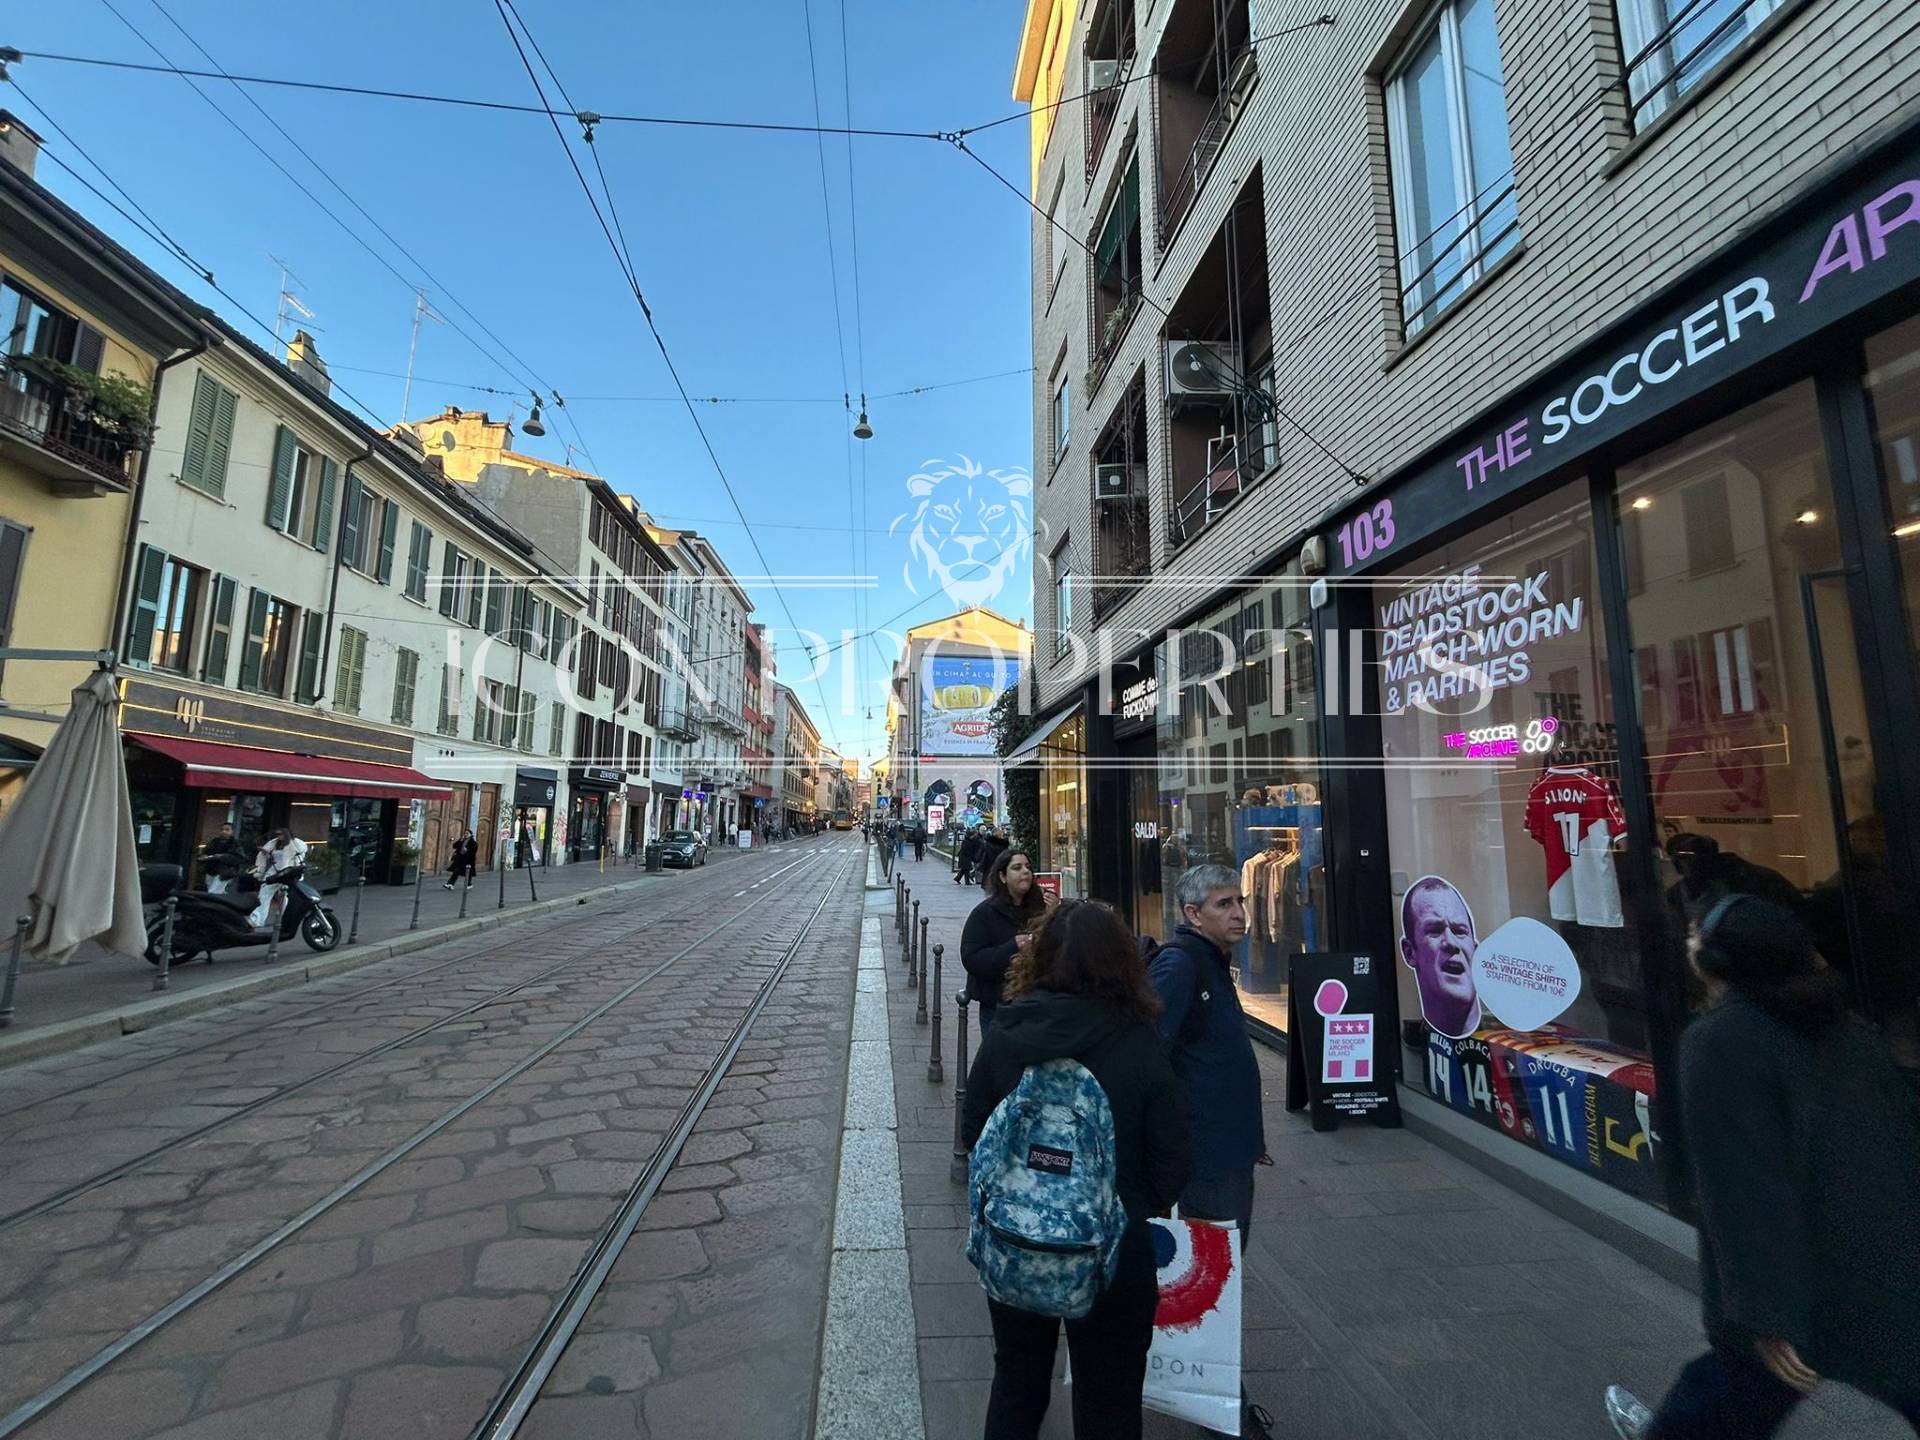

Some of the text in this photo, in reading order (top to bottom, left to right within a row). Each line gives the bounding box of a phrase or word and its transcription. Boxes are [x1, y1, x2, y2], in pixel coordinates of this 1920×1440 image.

[1456, 418, 1532, 490] THE
[1541, 276, 1776, 445] SOCCER
[1337, 498, 1395, 568] 103
[1381, 564, 1480, 627] VINTAGE
[1382, 571, 1549, 656] DEADSTOCK
[1384, 597, 1583, 684] MATCH-WORN
[1386, 651, 1531, 712] & RARITIES
[1443, 725, 1517, 748] THE SOCCER
[1466, 739, 1520, 759] ARCHIVE
[1135, 822, 1157, 838] SALDI
[1553, 811, 1580, 856] 11
[1481, 960, 1566, 987] 300+ VINTAGE SHIRTS
[1486, 970, 1565, 997] STARTING FROM 10€
[1498, 955, 1540, 971] SELECTION
[1542, 964, 1555, 974] OF
[1428, 1048, 1452, 1103] 14
[1463, 1063, 1492, 1113] 14
[1528, 1058, 1576, 1087] DROGBA
[1539, 1085, 1575, 1151] 11
[1585, 1083, 1602, 1168] BELLINGHAM
[1152, 1355, 1204, 1377] DON
